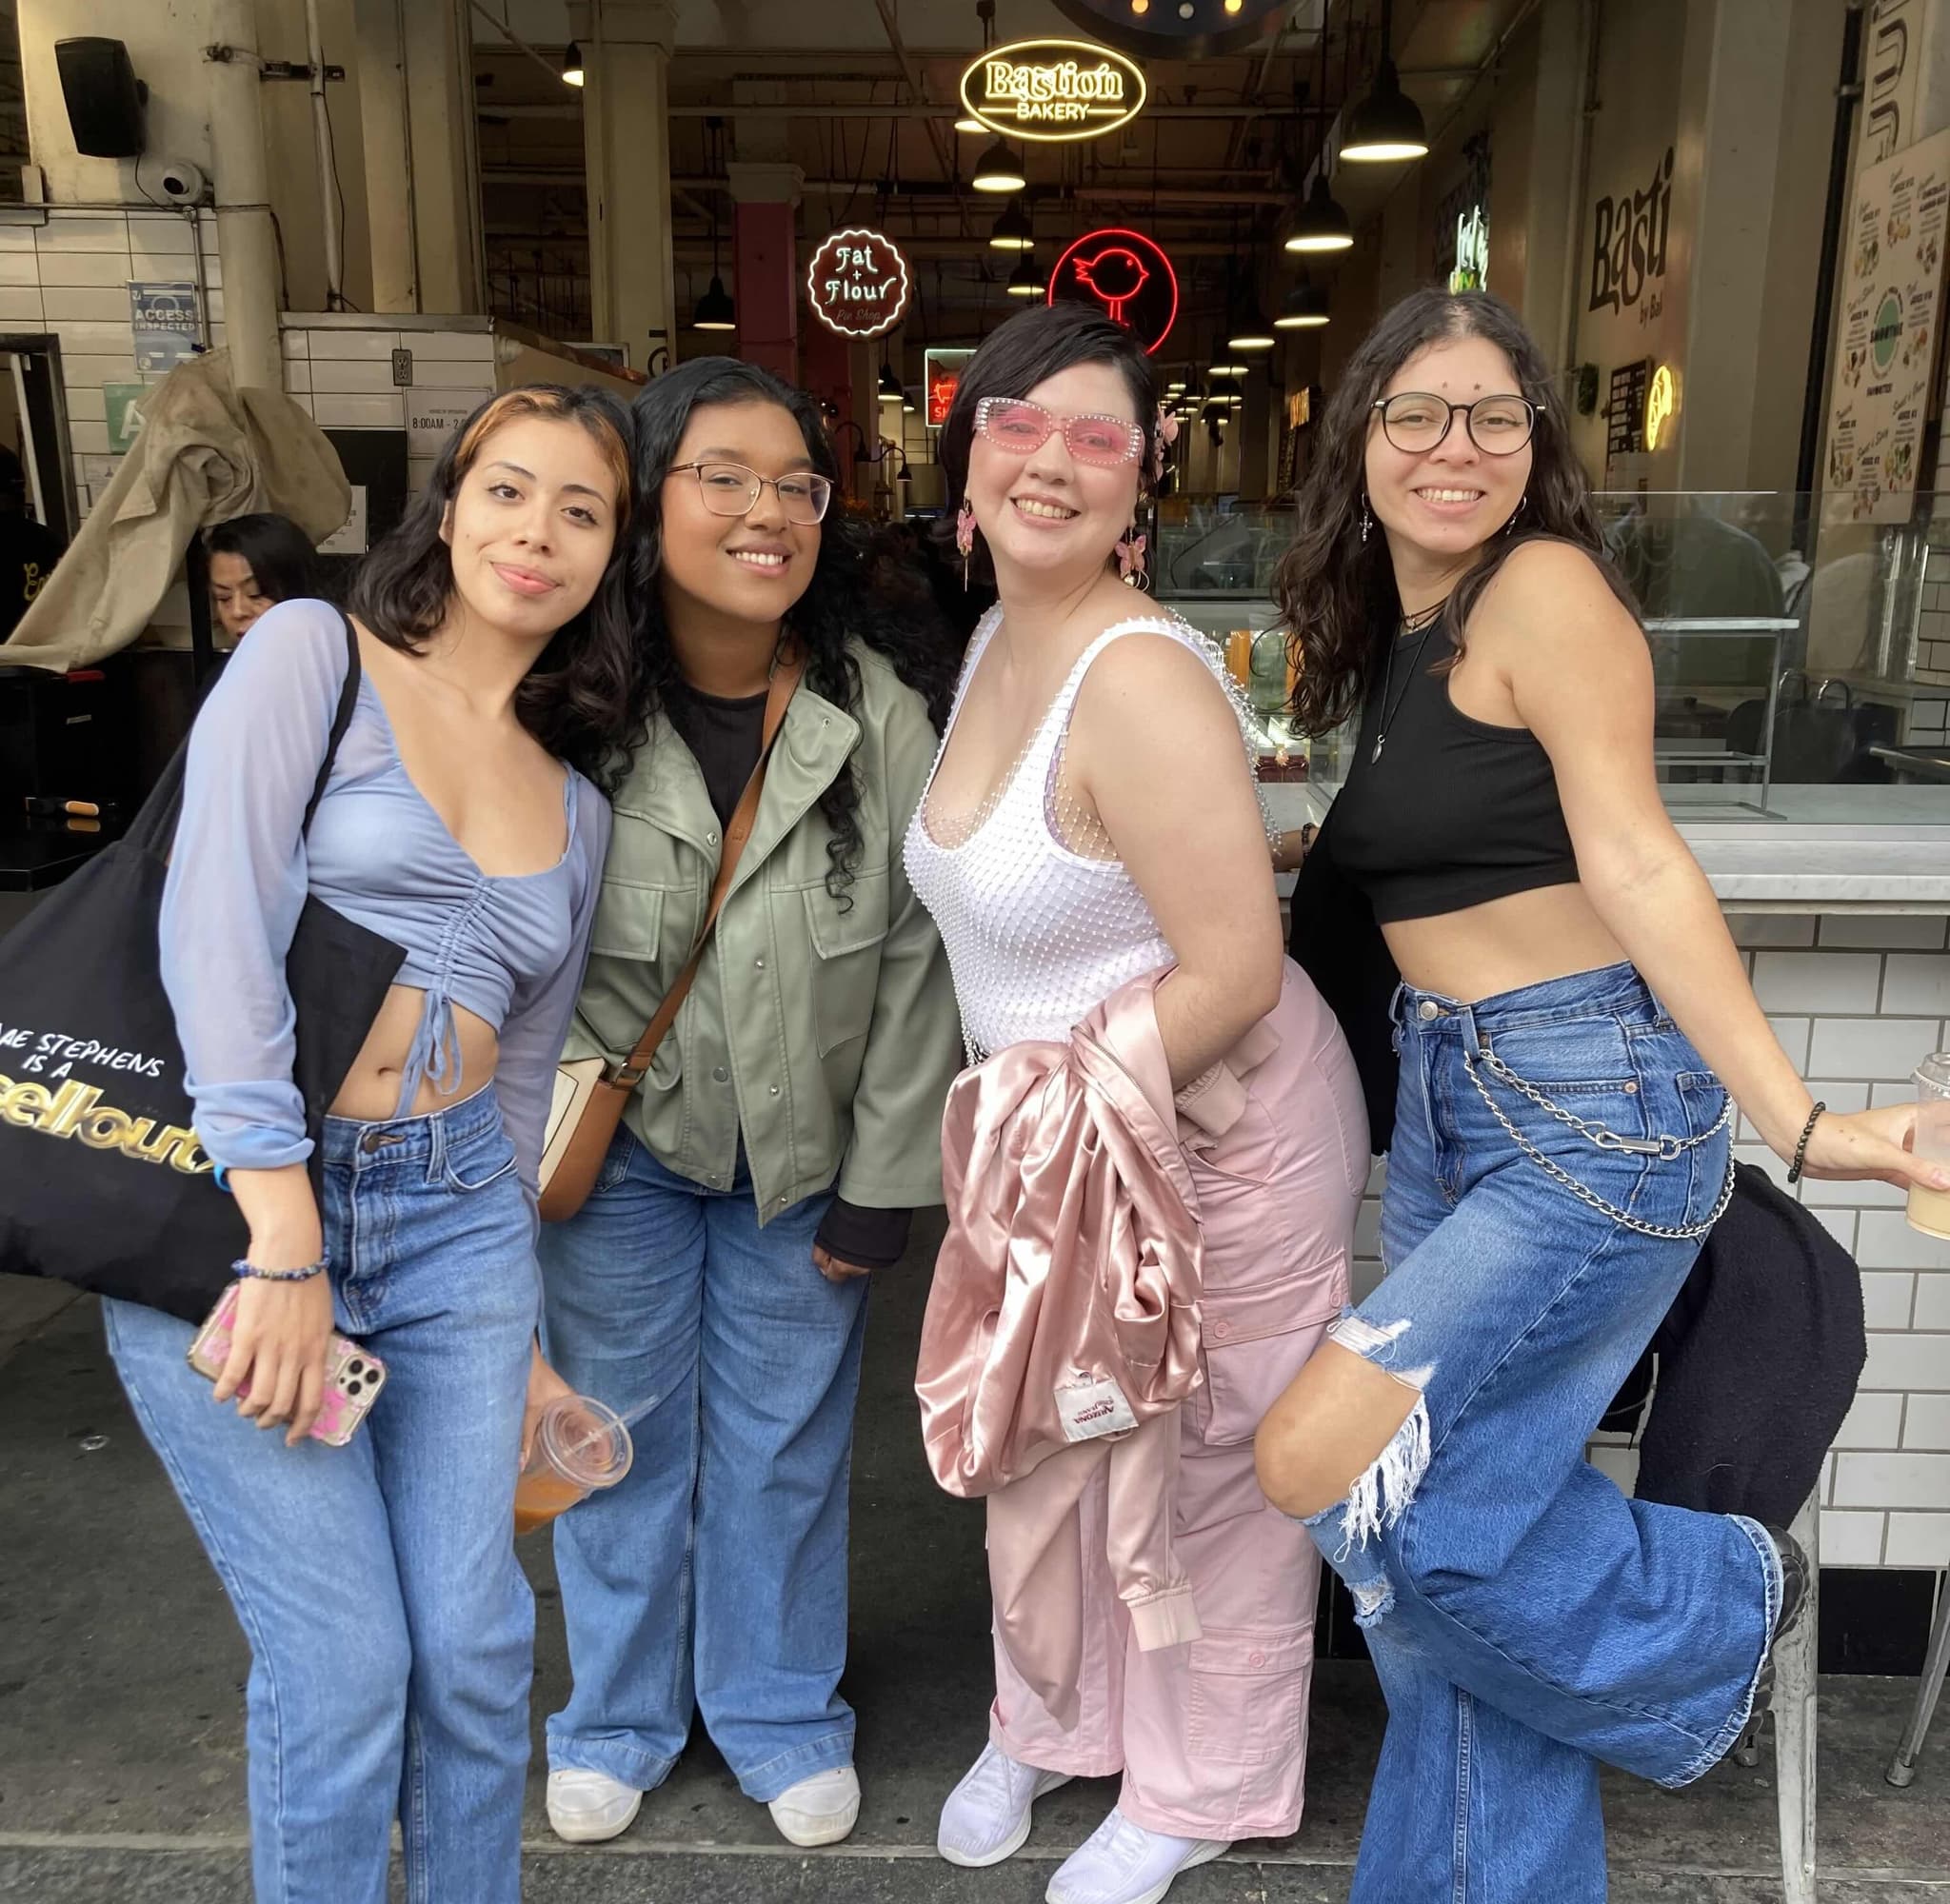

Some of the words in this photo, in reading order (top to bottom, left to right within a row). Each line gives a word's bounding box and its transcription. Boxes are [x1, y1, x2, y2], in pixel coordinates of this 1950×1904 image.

[985, 61, 1124, 102] Bastion
[1017, 102, 1089, 121] BAKERY
[1588, 146, 1675, 316] Basti
[835, 244, 878, 273] Fat
[825, 277, 897, 306] Flour
[135, 309, 193, 322] ACCESS
[135, 322, 196, 332] INSPECTED
[856, 308, 883, 322] Shop
[120, 400, 147, 439] A
[412, 417, 444, 429] 8:00AM
[21, 1054, 48, 1073] IS
[50, 1061, 74, 1079] A
[36, 1033, 165, 1078] STEPHENS
[1074, 1406, 1114, 1424] ARIZONA
